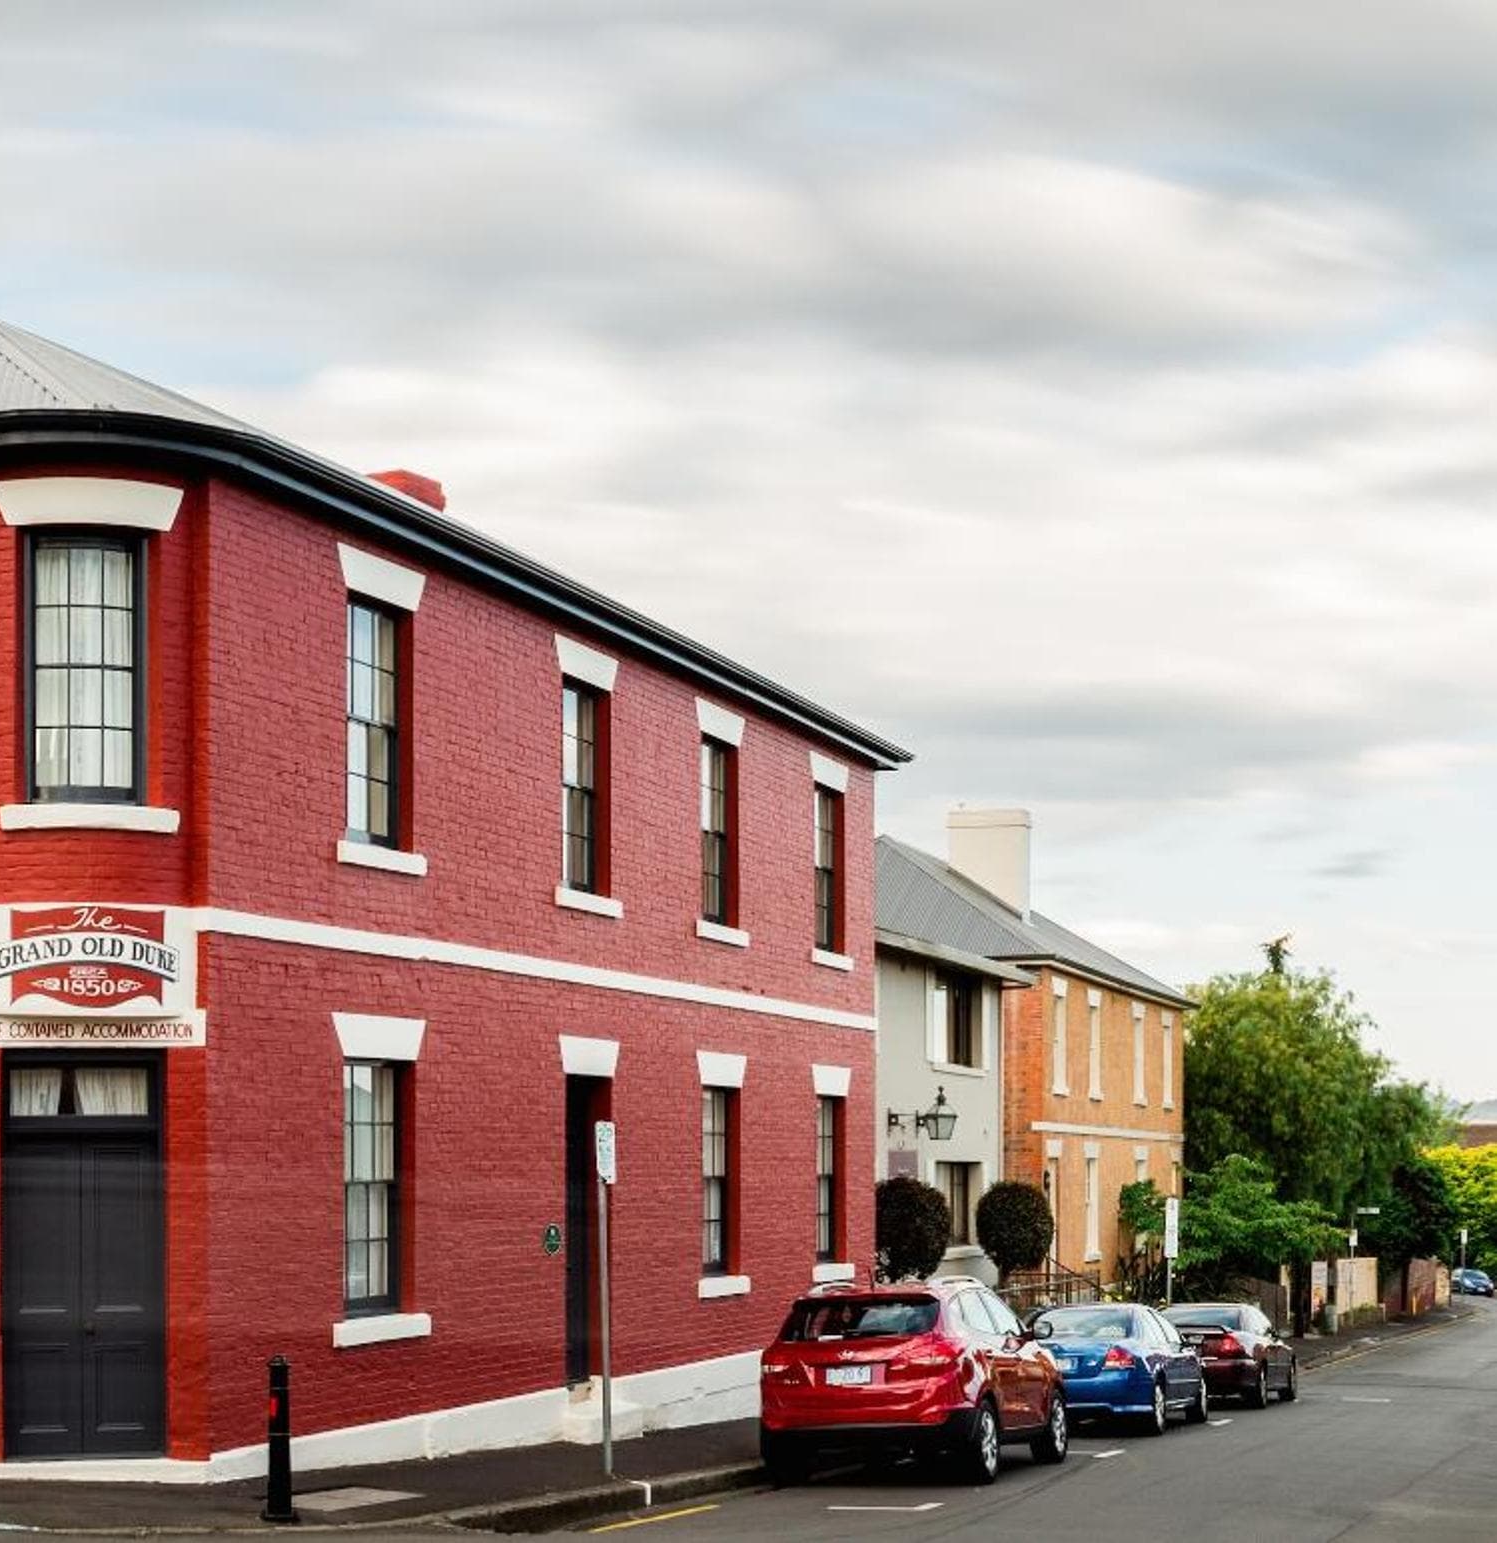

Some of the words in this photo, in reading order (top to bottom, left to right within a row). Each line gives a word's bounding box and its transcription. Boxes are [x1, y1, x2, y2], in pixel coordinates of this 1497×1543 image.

[59, 907, 122, 930] The
[81, 937, 124, 957] OLD
[131, 940, 177, 973] DUKE
[63, 979, 116, 997] 1850
[9, 1022, 75, 1039] CONTAINED
[81, 1022, 194, 1039] ACCOMMODATION
